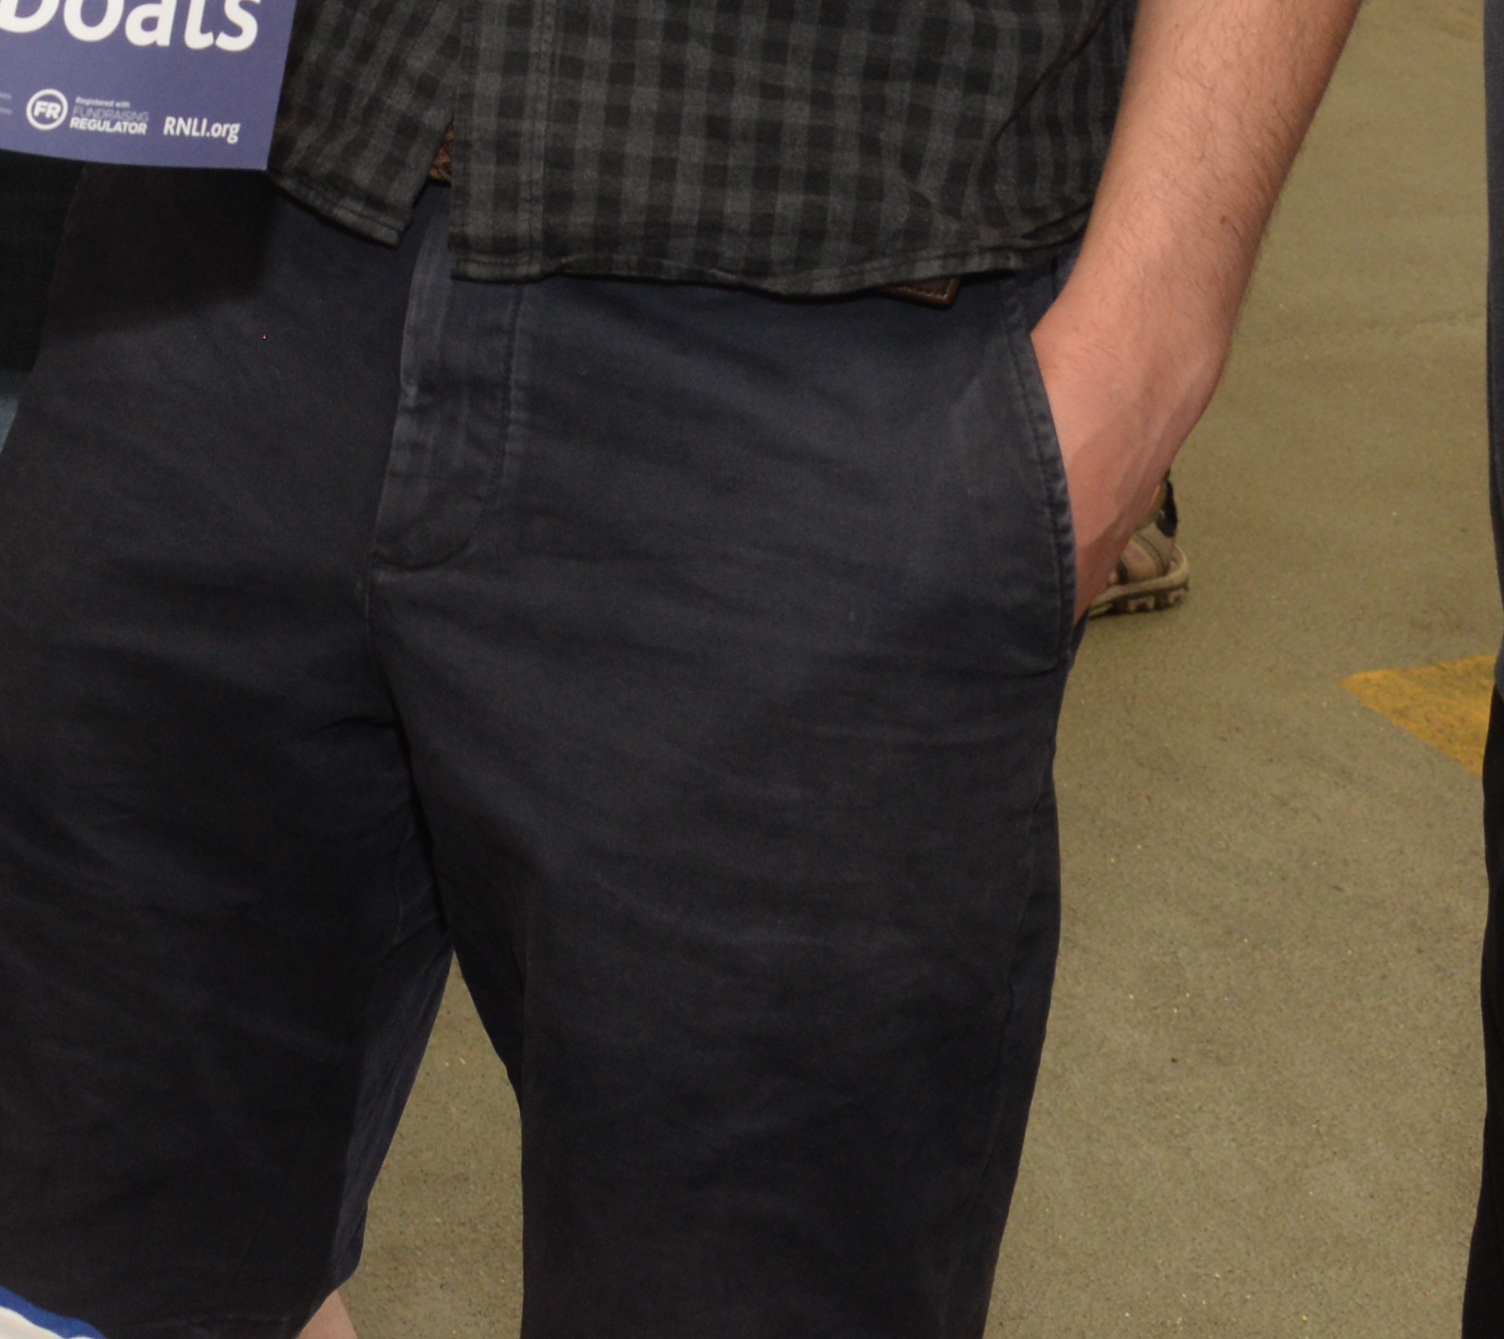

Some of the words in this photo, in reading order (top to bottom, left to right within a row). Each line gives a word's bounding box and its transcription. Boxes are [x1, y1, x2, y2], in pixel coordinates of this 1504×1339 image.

[34, 101, 61, 119] FR
[163, 115, 240, 143] RNLI.org
[70, 116, 147, 135] REGULATOR
